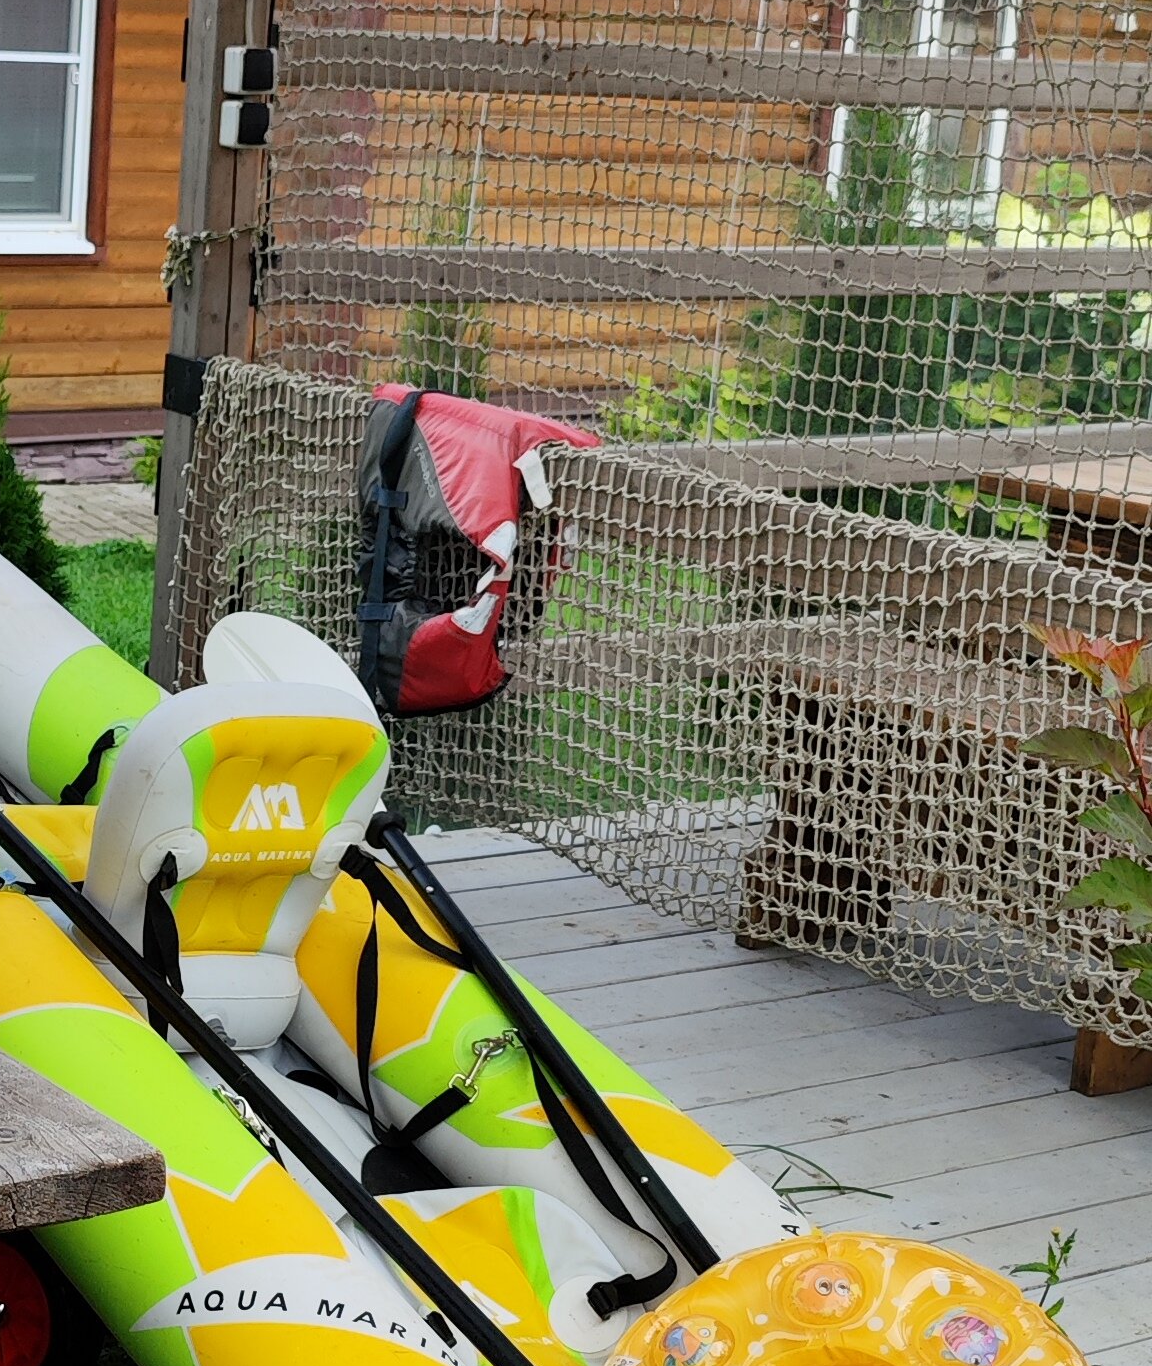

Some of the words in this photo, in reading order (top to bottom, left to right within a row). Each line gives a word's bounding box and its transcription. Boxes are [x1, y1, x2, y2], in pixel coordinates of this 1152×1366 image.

[209, 851, 253, 863] AQUA
[257, 849, 313, 862] MARINA
[175, 1289, 288, 1315] AQUA
